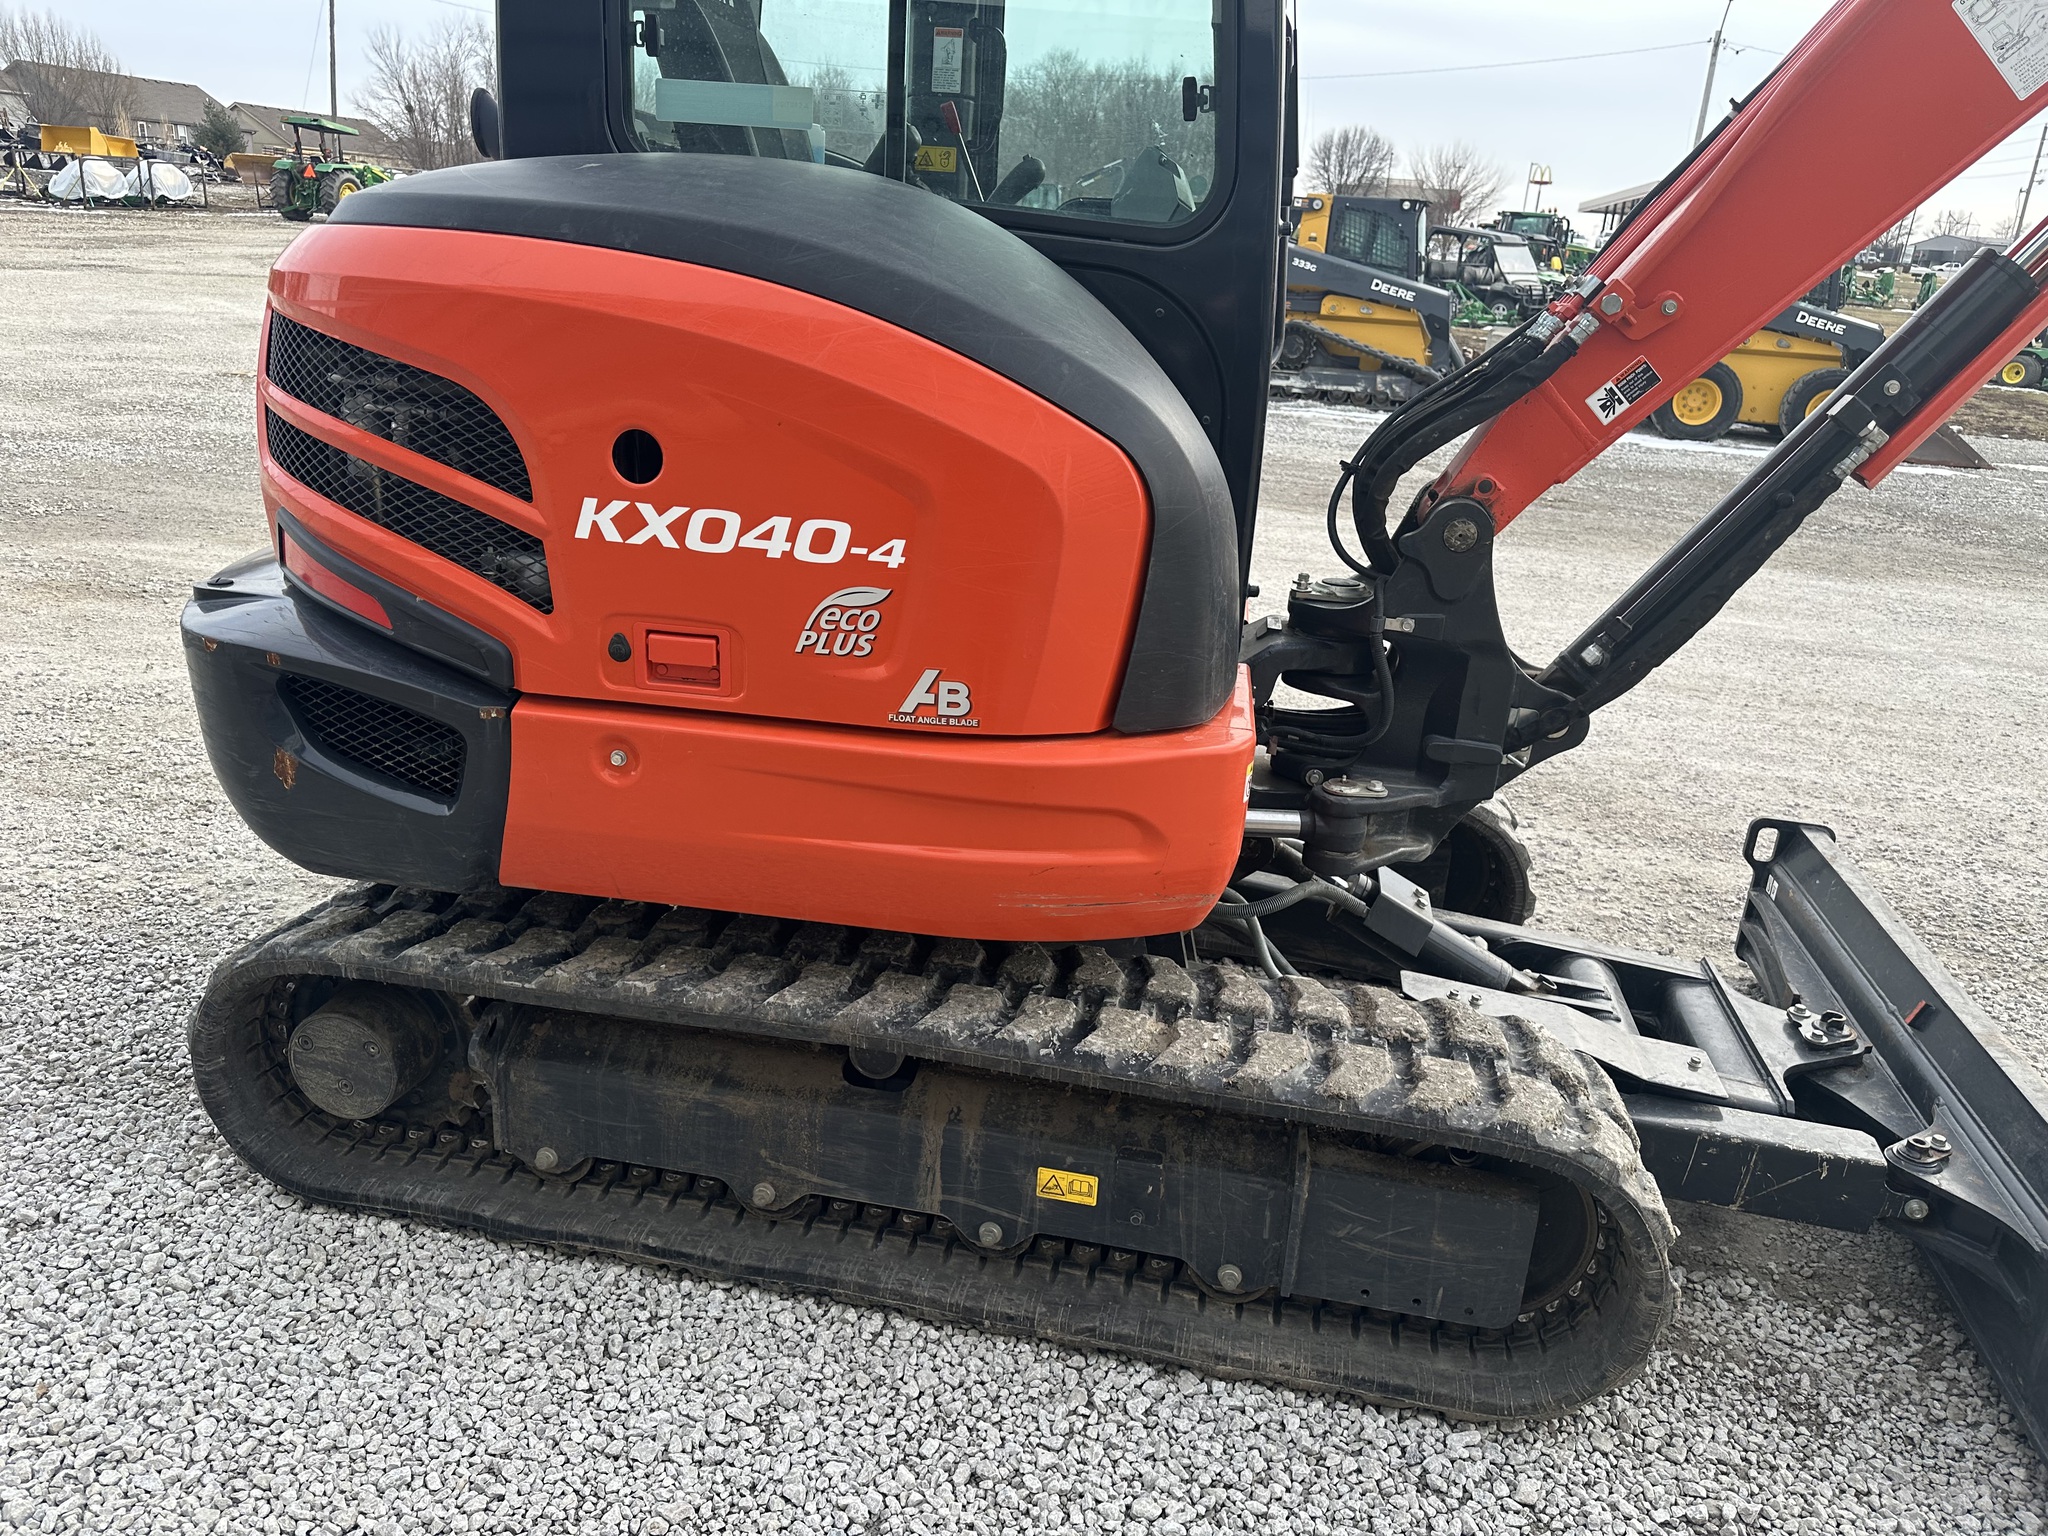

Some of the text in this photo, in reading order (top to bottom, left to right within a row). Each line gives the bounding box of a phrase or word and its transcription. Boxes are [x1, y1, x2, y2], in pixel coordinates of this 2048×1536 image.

[1292, 258, 1317, 272] 333G
[1370, 278, 1416, 301] DEERE
[1795, 310, 1847, 335] DEERE
[1620, 360, 1642, 378] WARNING
[574, 497, 906, 569] KX040-4
[819, 607, 881, 632] eco
[794, 630, 876, 657] PLUS
[888, 714, 979, 727] FLOAT ANGLE BLADE
